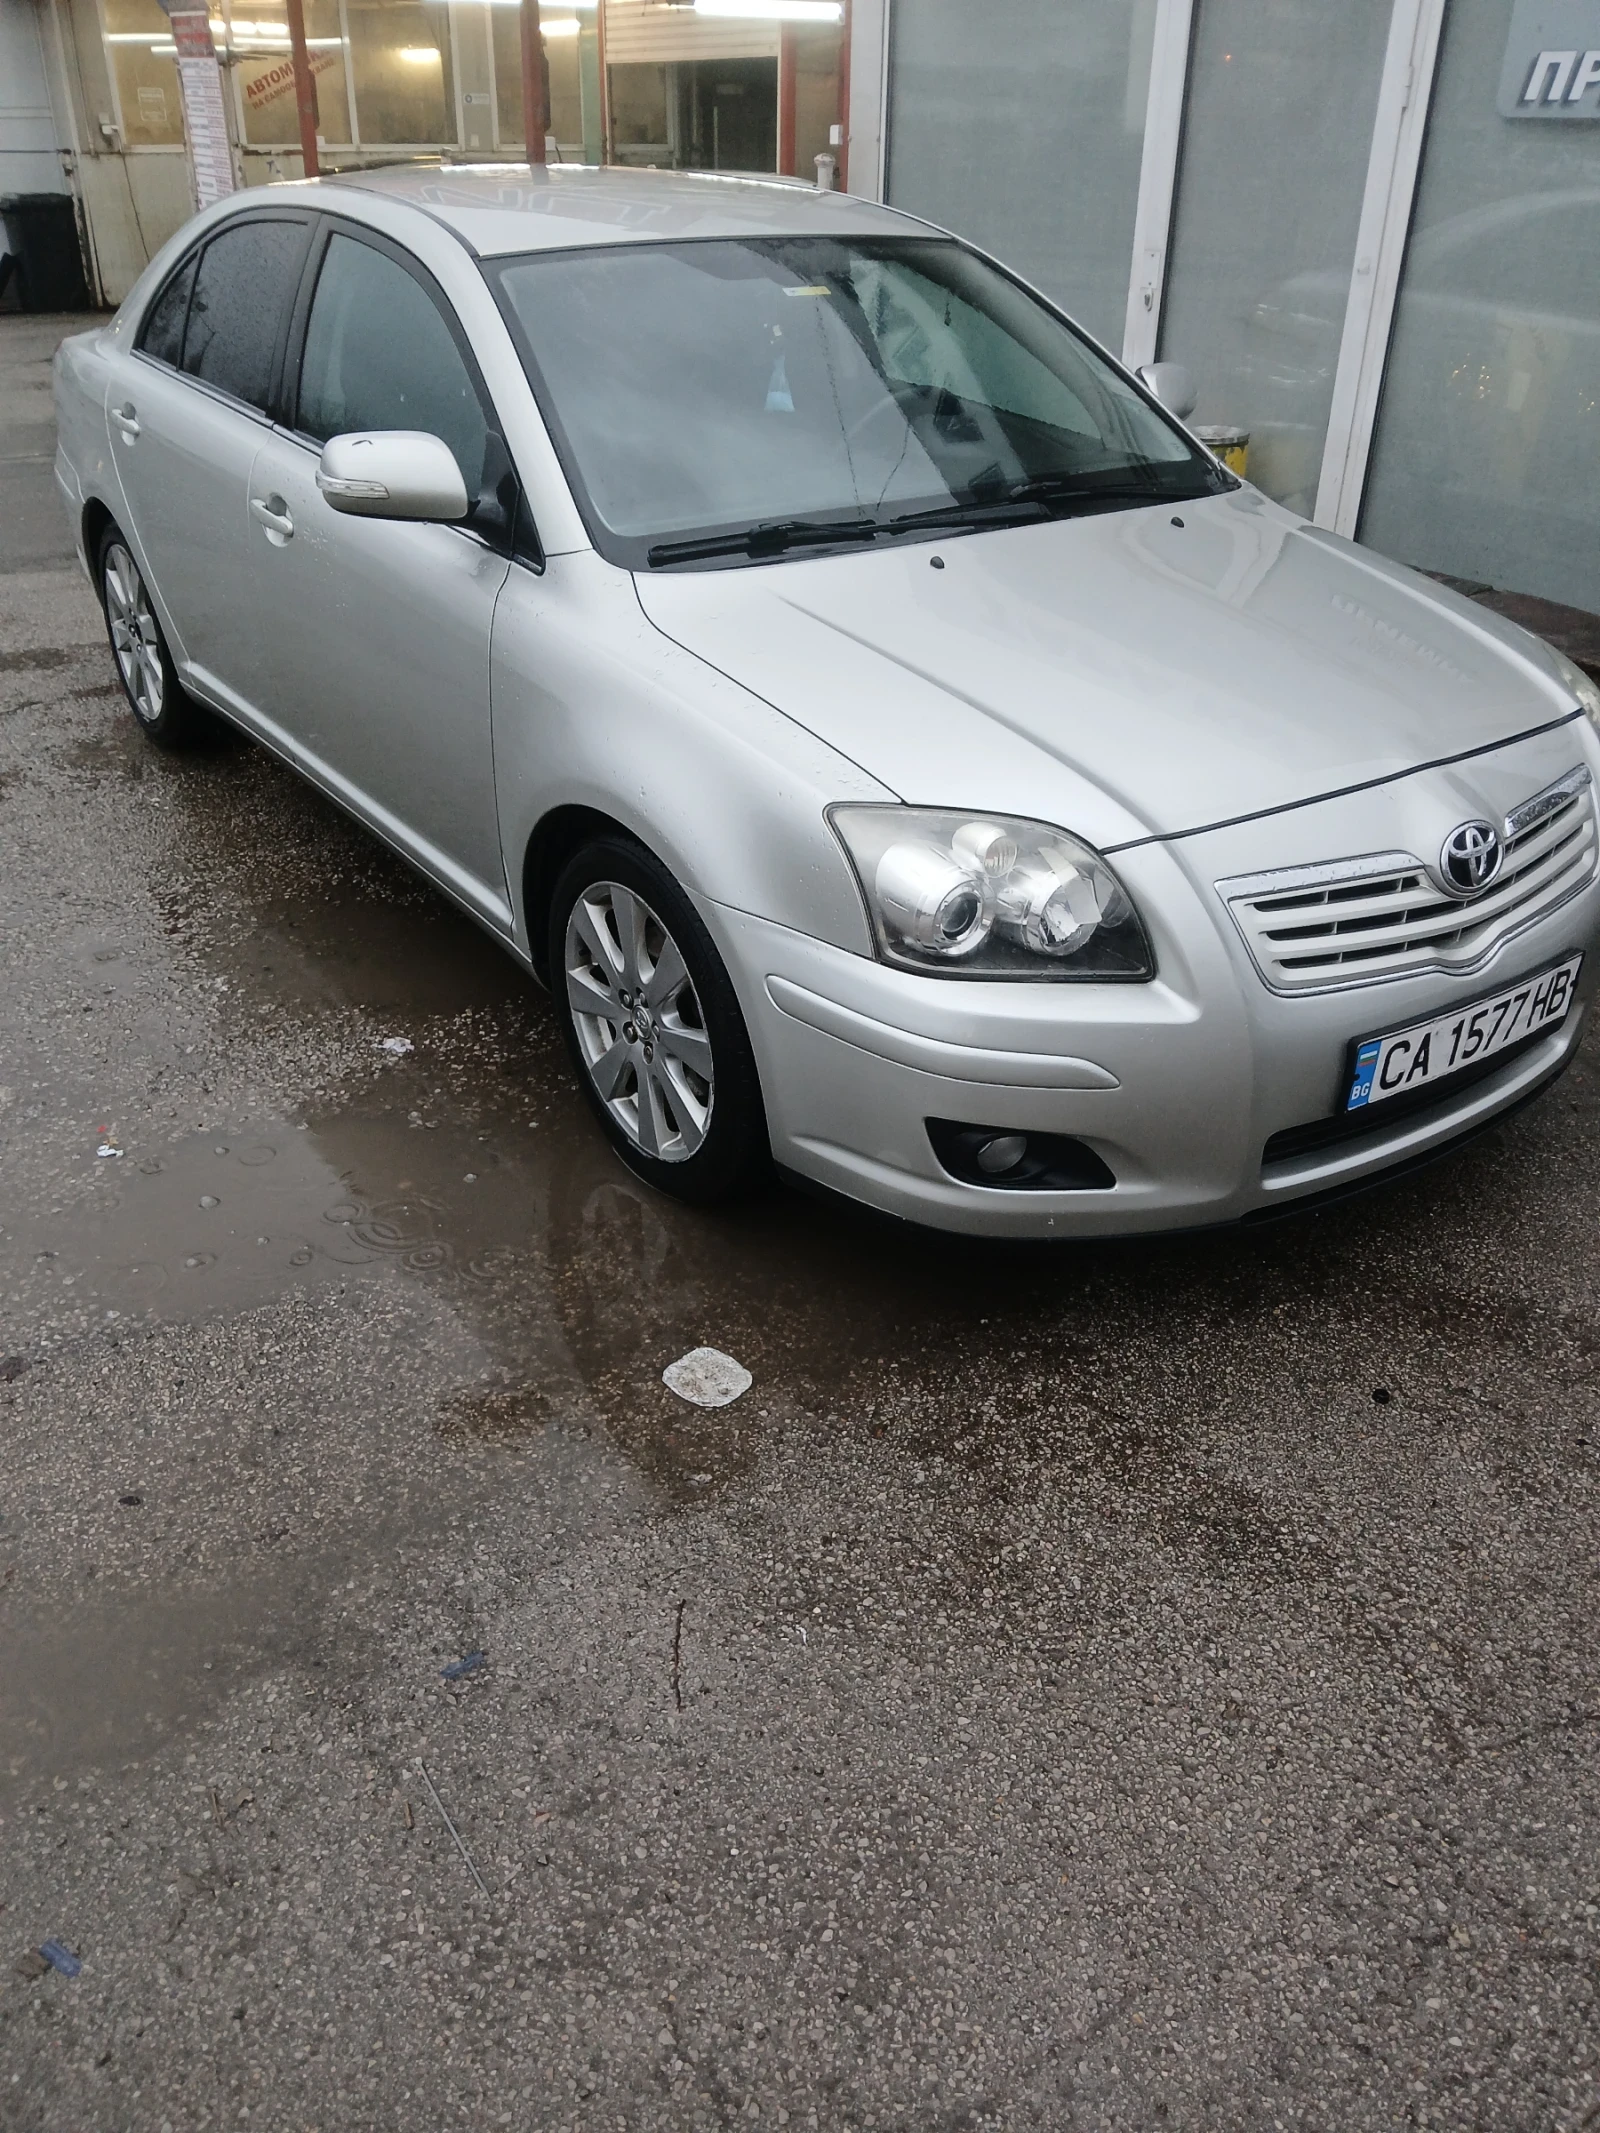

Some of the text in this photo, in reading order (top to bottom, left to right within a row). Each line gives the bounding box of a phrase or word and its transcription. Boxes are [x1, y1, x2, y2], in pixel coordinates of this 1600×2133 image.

[1380, 969, 1571, 1090] CA 1577 HB
[1351, 1083, 1370, 1100] BG
